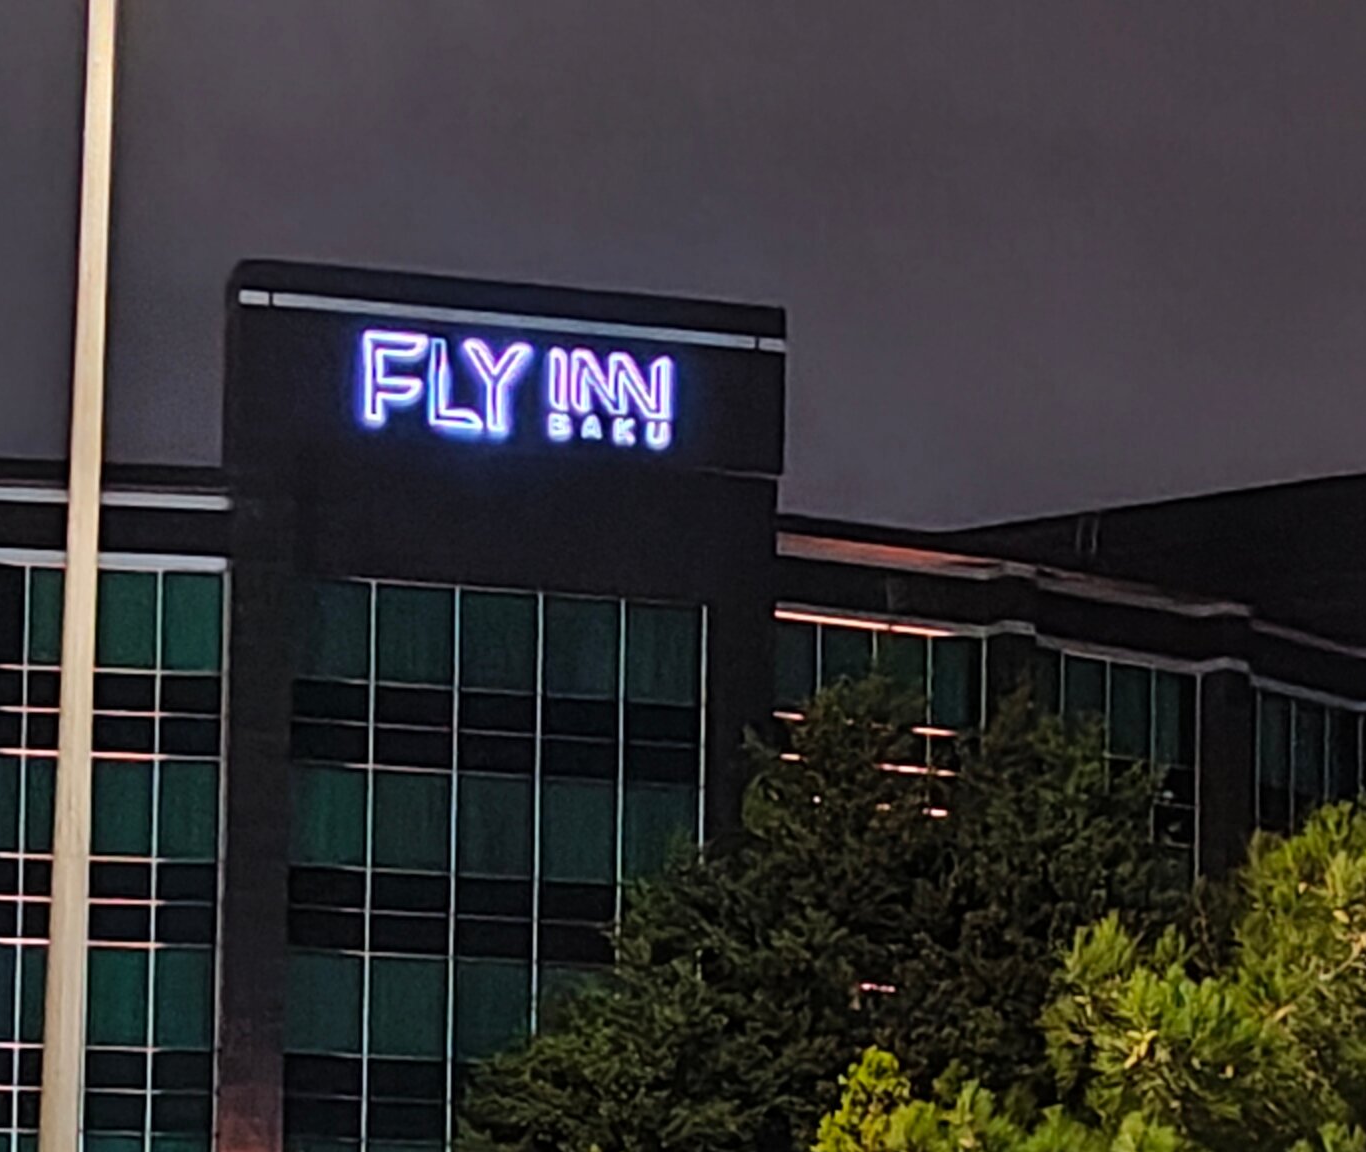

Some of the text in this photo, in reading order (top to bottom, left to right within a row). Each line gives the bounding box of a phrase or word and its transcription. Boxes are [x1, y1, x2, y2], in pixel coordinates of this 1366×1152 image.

[362, 329, 672, 434] FLY INN
[548, 412, 671, 448] BAKU
